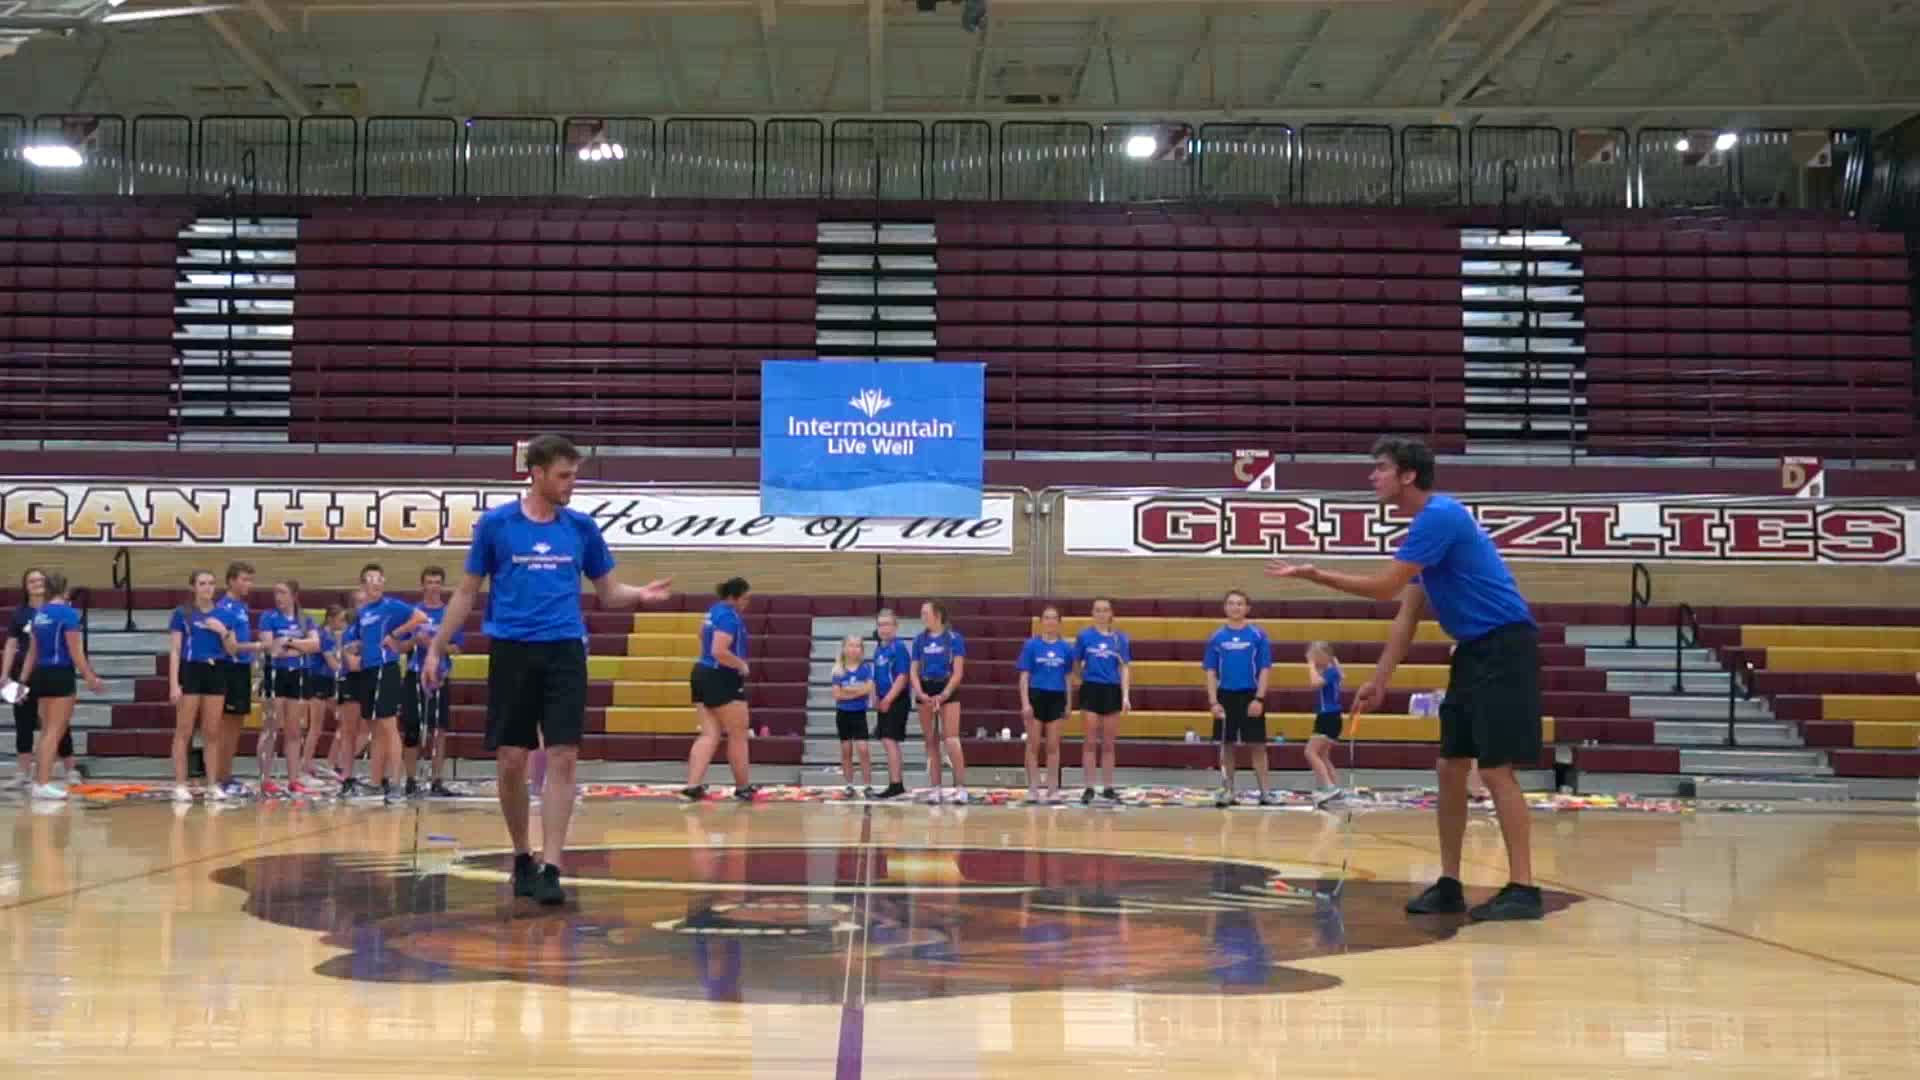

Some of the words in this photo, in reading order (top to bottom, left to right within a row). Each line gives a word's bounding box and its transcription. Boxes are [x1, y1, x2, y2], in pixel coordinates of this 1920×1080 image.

[788, 415, 953, 438] Intermountain
[872, 439, 914, 455] Well
[1234, 458, 1254, 482] C
[1782, 464, 1806, 489] D
[590, 500, 775, 537] Home
[801, 516, 872, 550] of
